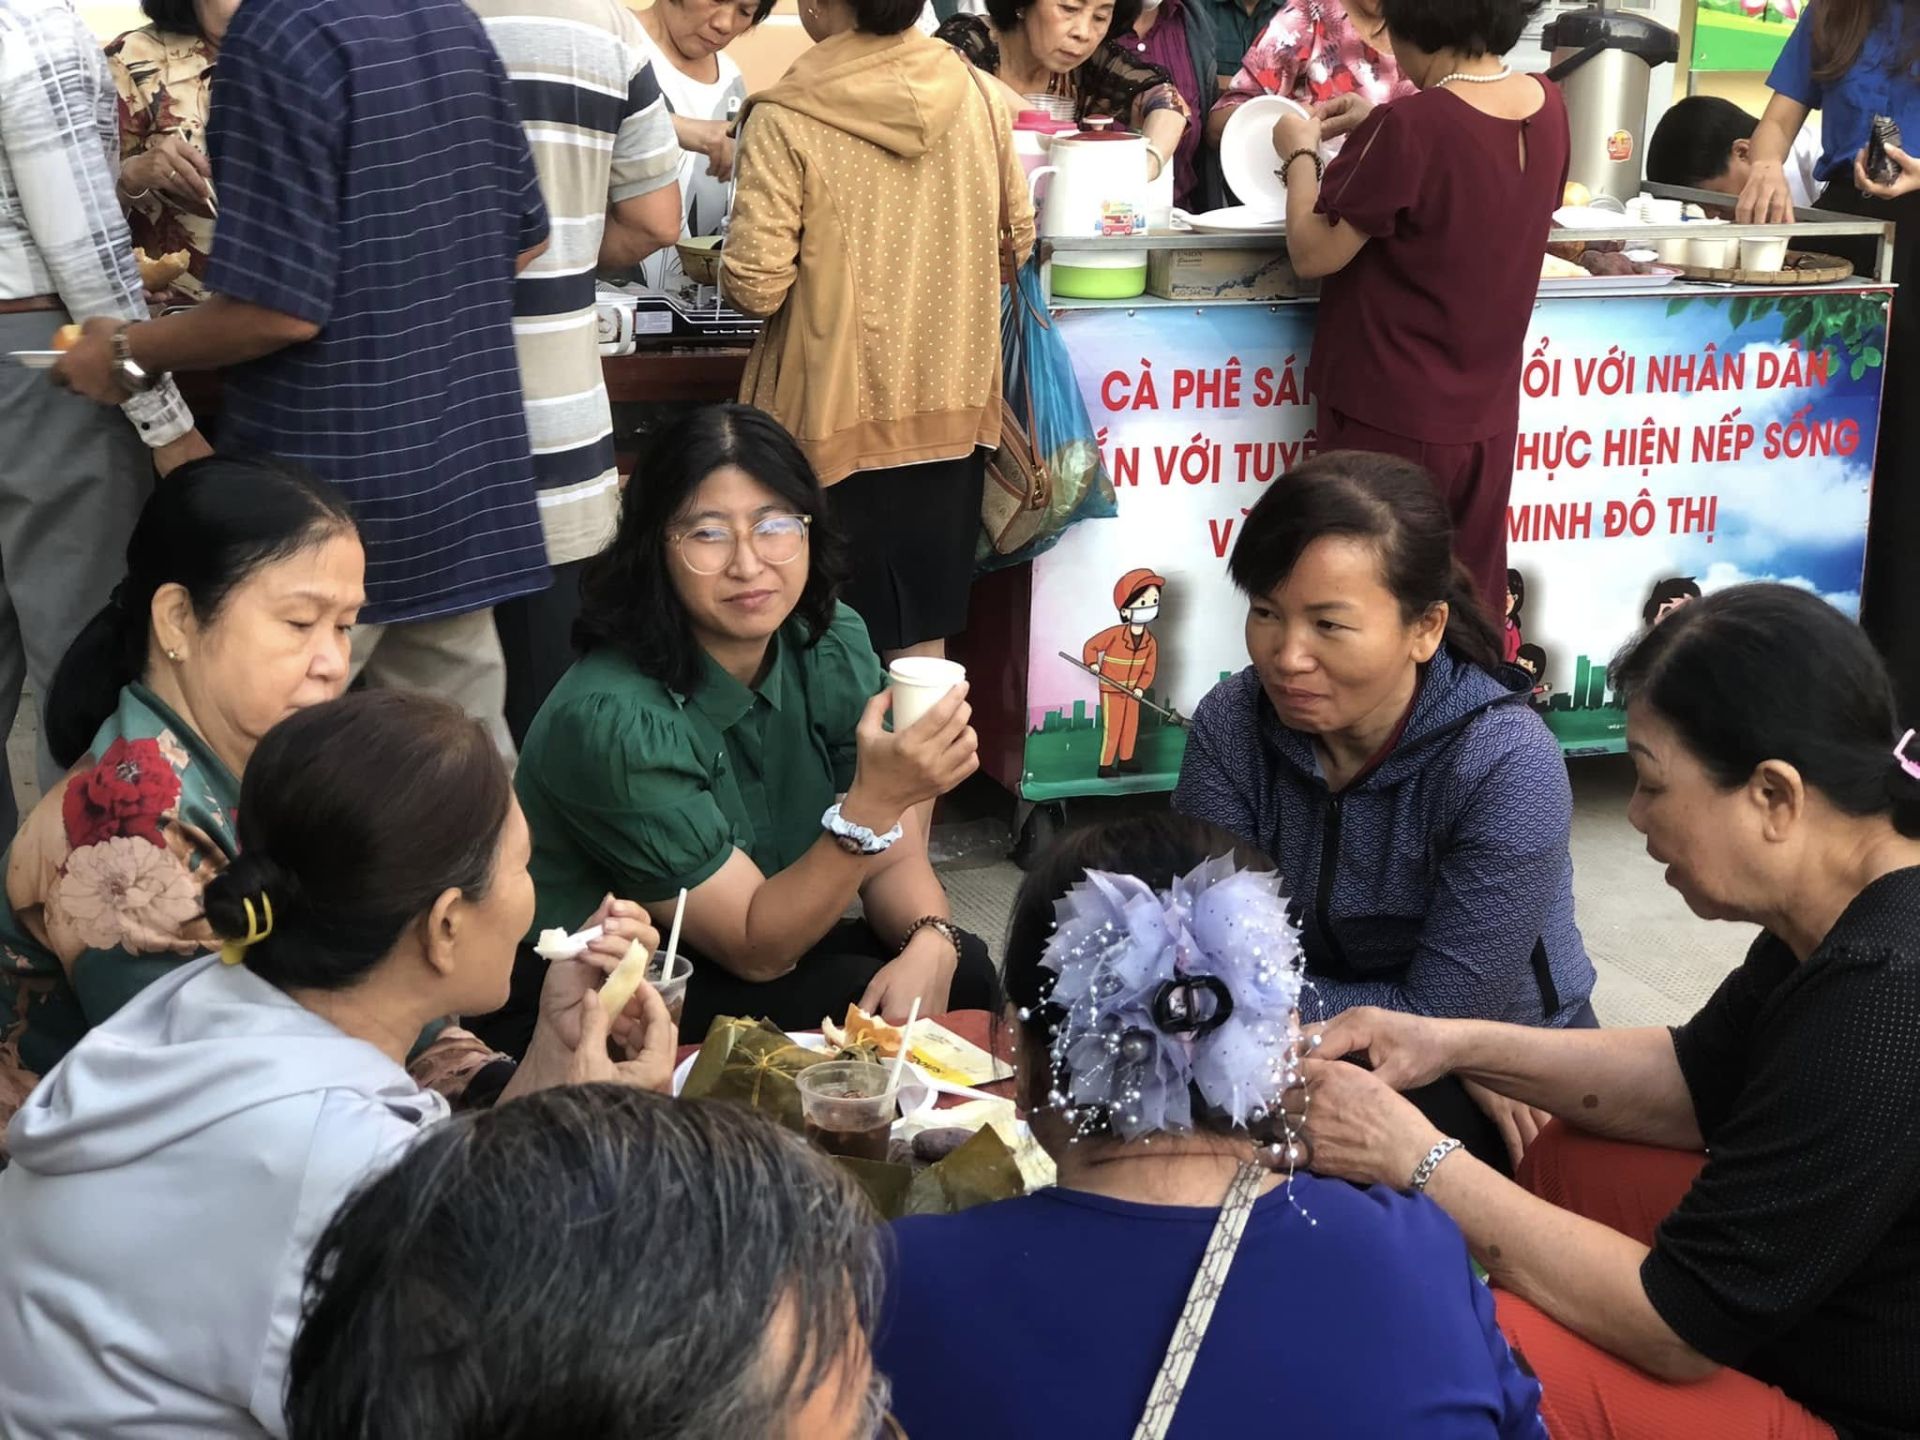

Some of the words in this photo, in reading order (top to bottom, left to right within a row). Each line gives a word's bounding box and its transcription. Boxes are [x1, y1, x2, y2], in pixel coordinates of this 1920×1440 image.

[1101, 358, 1159, 411] CÀ
[1172, 356, 1242, 409] PHÊ
[1574, 345, 1636, 397] VỚI
[1646, 343, 1746, 393] NHÂN
[1756, 339, 1830, 390] DÂN
[1154, 433, 1222, 486] VỚI
[1602, 416, 1681, 477] HIỆN
[1691, 407, 1755, 463] NẾP
[1763, 404, 1860, 460] SỐNG
[1505, 502, 1592, 543] MINH
[1603, 488, 1657, 537] ĐÔ
[1667, 495, 1718, 544] THỊ
